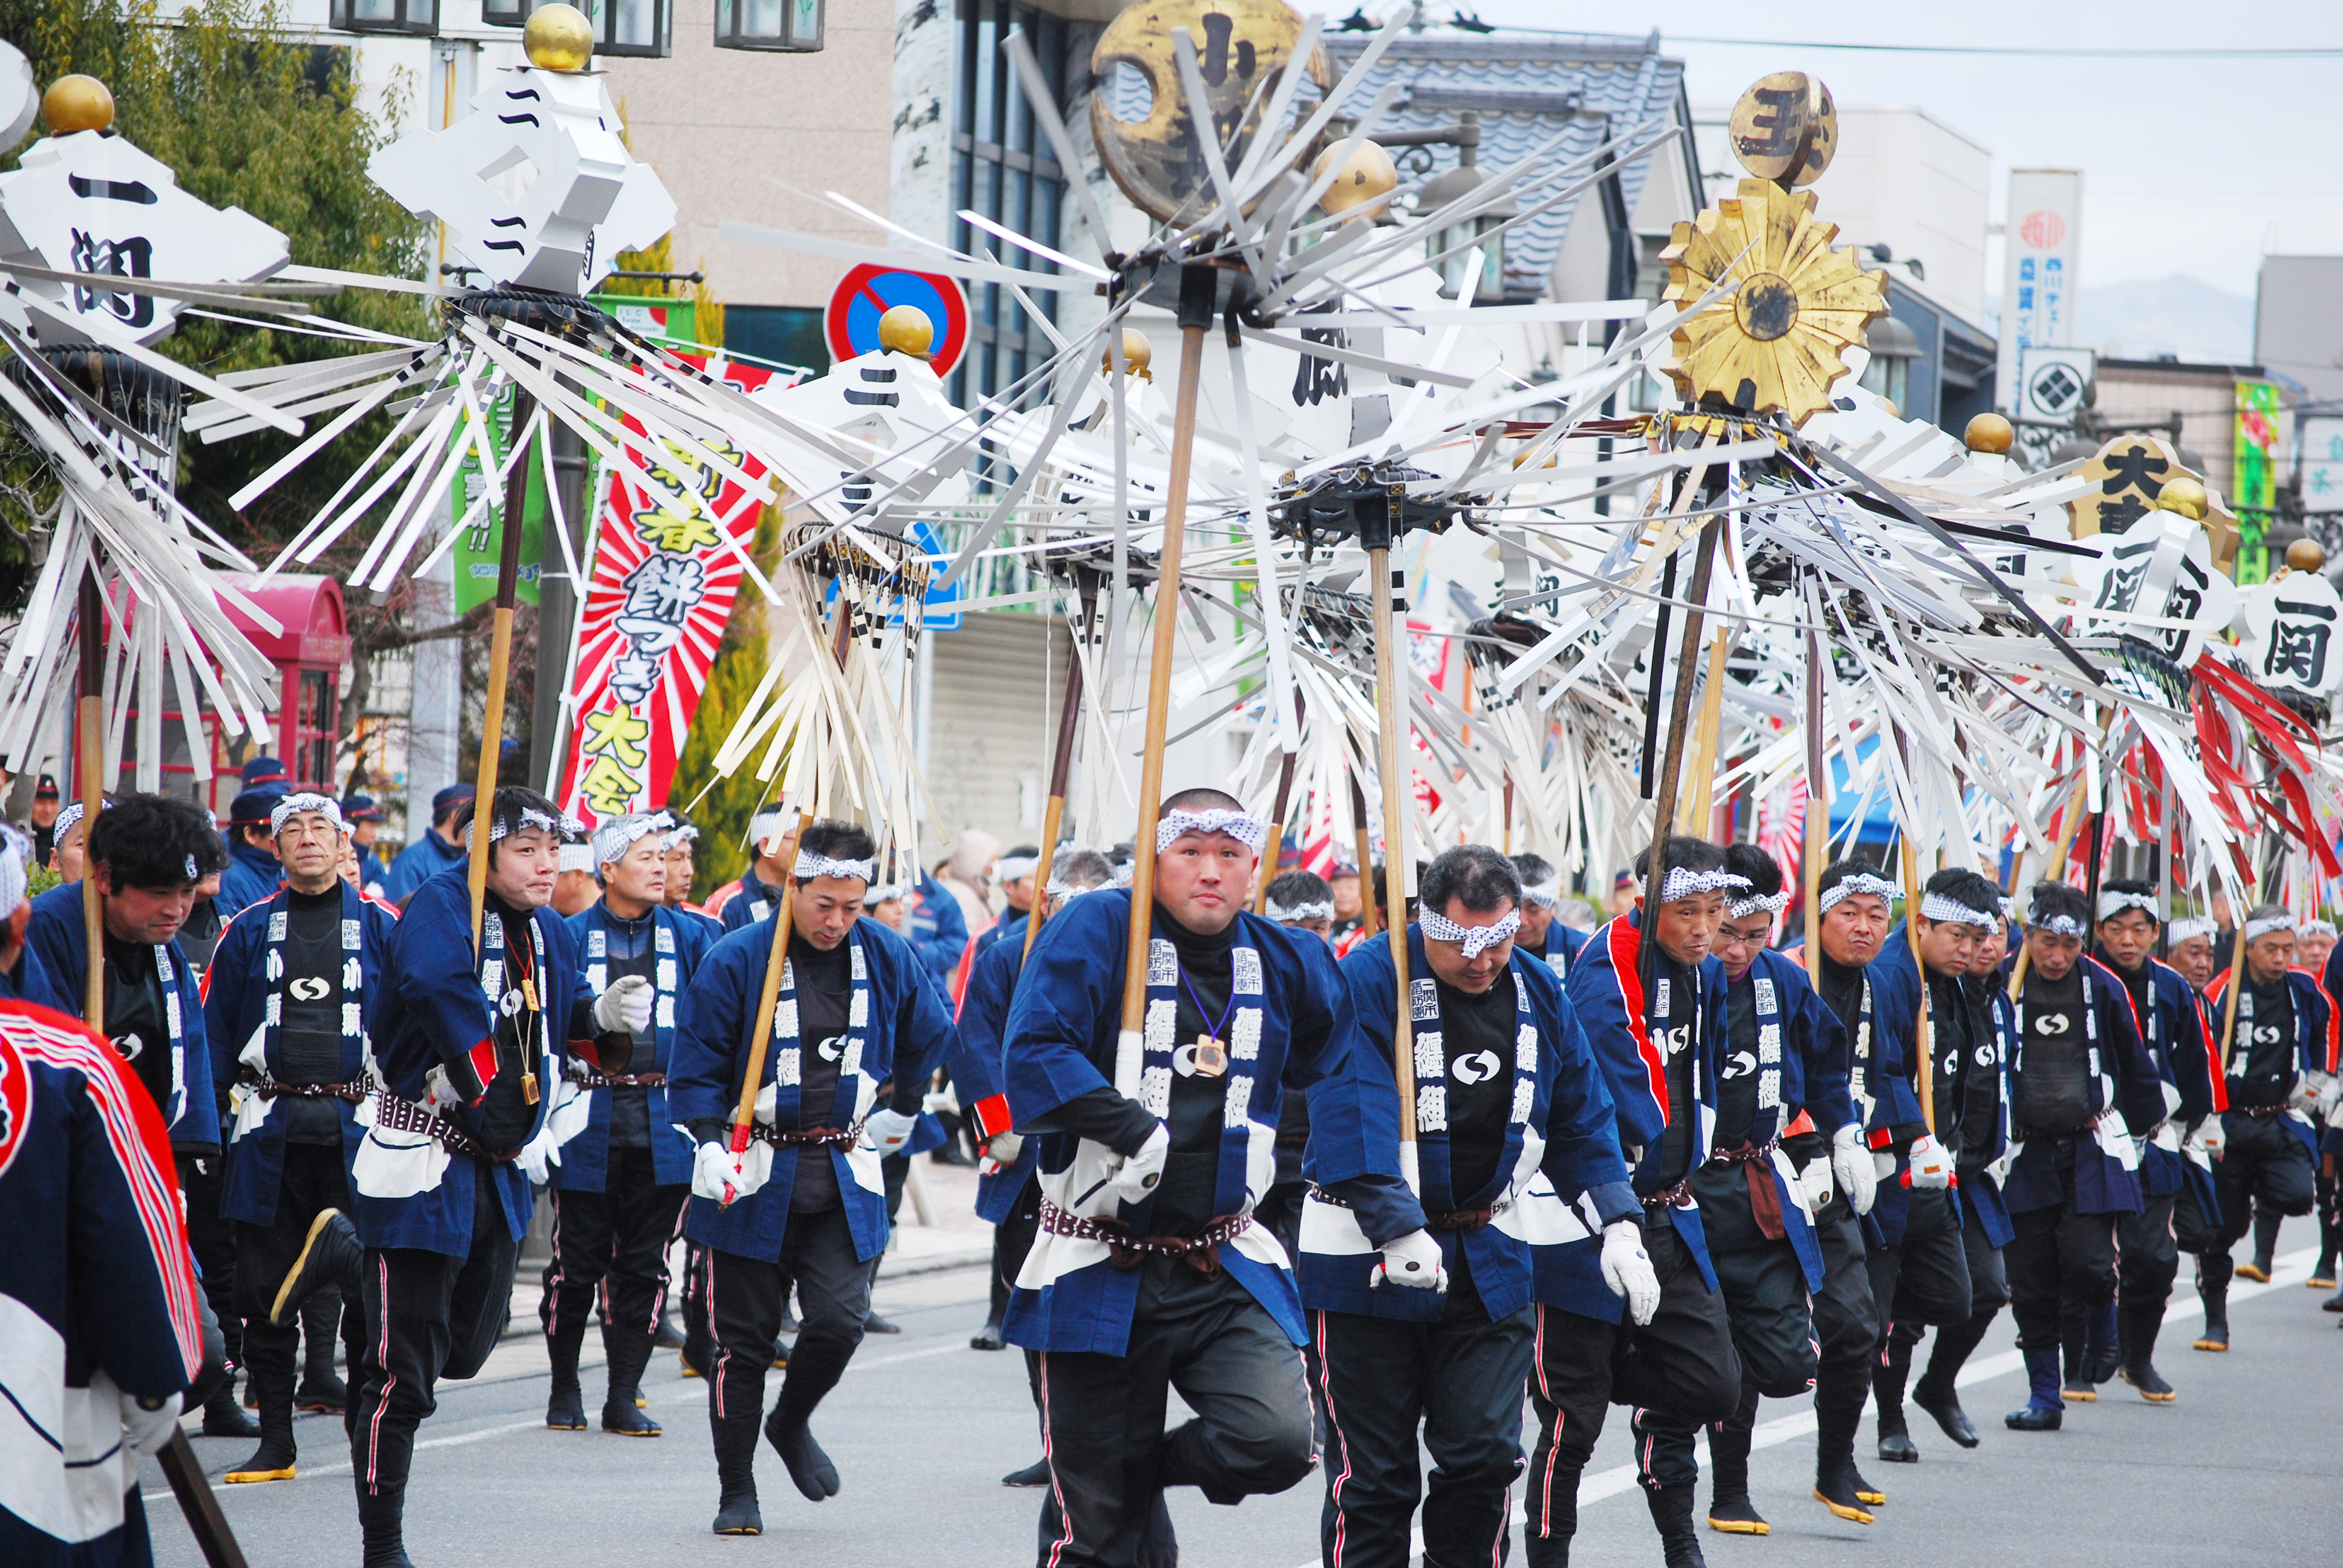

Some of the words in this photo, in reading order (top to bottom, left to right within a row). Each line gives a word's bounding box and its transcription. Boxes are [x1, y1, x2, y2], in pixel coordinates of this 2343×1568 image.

[2042, 256, 2063, 347] 西川チェー
[2264, 596, 2337, 688] 一関
